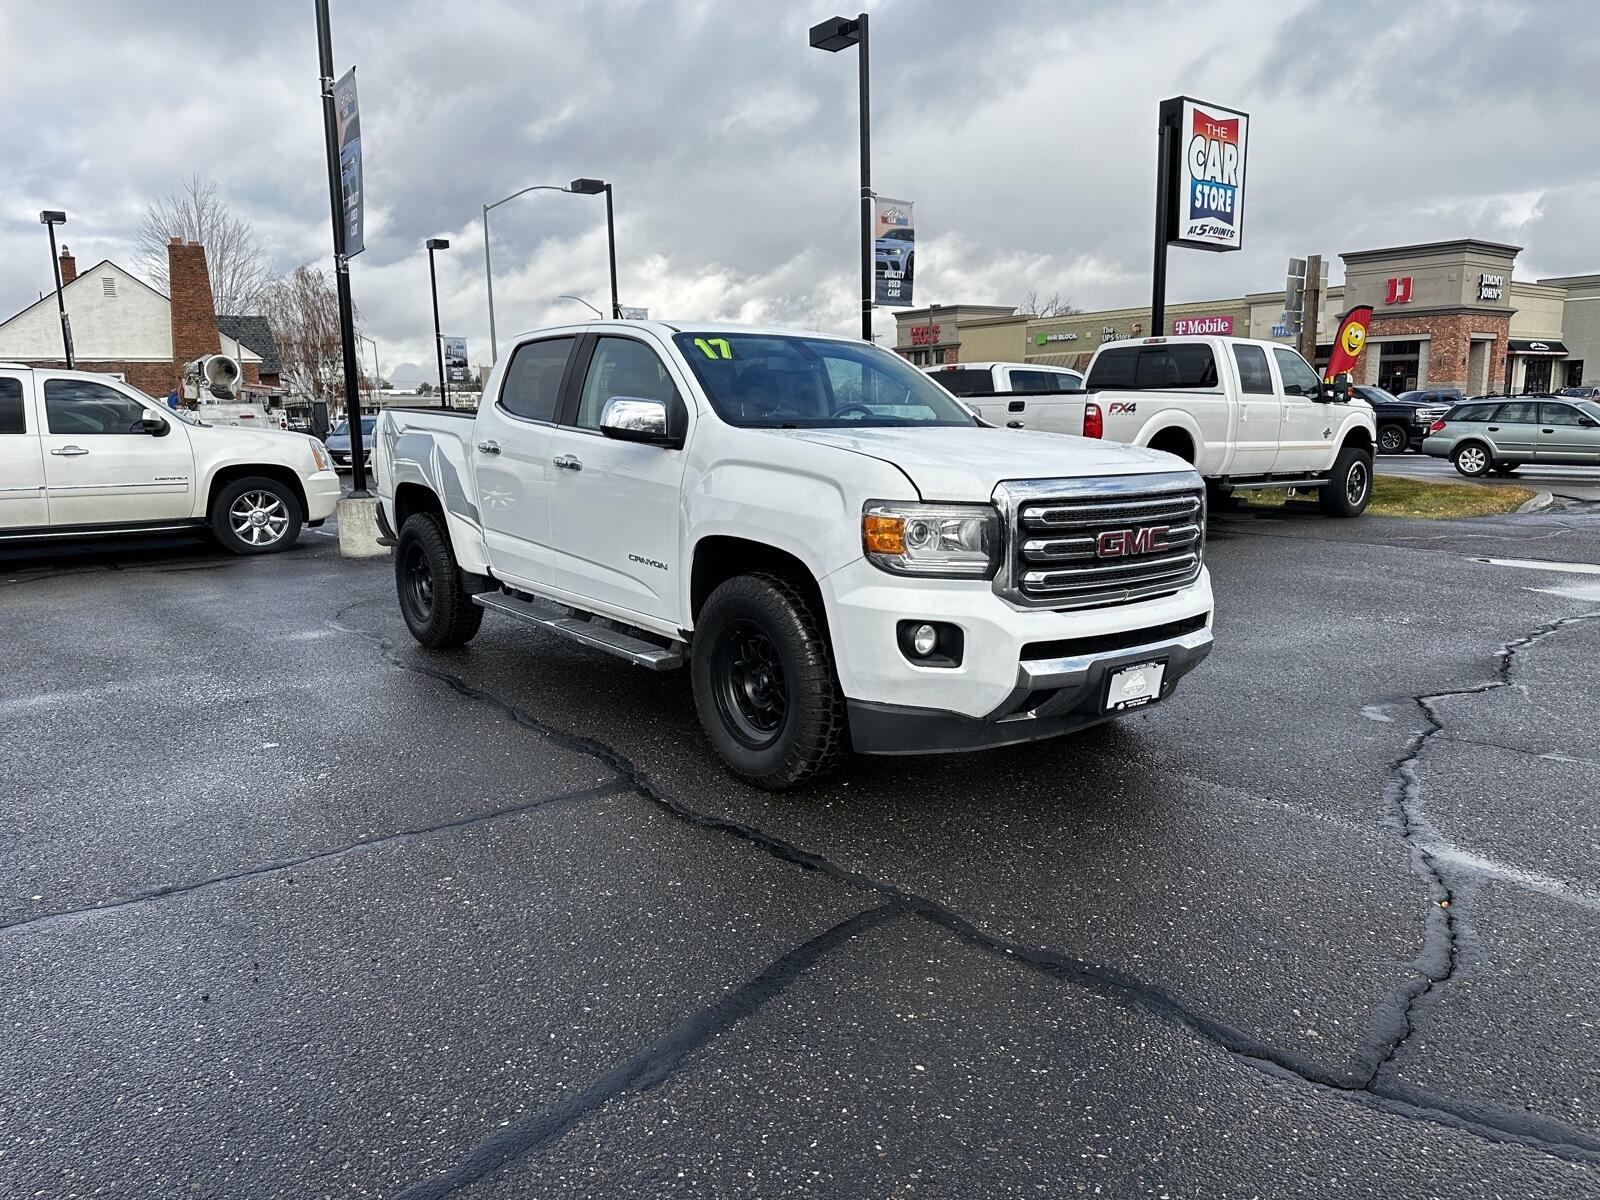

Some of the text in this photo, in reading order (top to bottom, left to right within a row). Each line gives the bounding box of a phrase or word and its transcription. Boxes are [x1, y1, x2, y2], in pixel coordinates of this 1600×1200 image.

[1205, 123, 1228, 139] THE
[1188, 134, 1239, 188] CAR
[1195, 184, 1232, 213] STORE
[1187, 224, 1236, 238] AT 5 POINTS
[884, 270, 905, 279] QUALITY
[1480, 273, 1504, 286] JIMMY
[888, 279, 901, 288] USED
[887, 288, 901, 297] CARS
[1480, 287, 1503, 300] JOHN'S
[1102, 326, 1114, 334] The
[1187, 318, 1229, 335] Mobile
[1058, 333, 1078, 341] BLOCK
[1101, 333, 1115, 342] UPS
[694, 338, 732, 360] 17
[1108, 402, 1137, 413] FX4
[1096, 525, 1170, 559] GMC
[628, 553, 668, 571] CANYON
